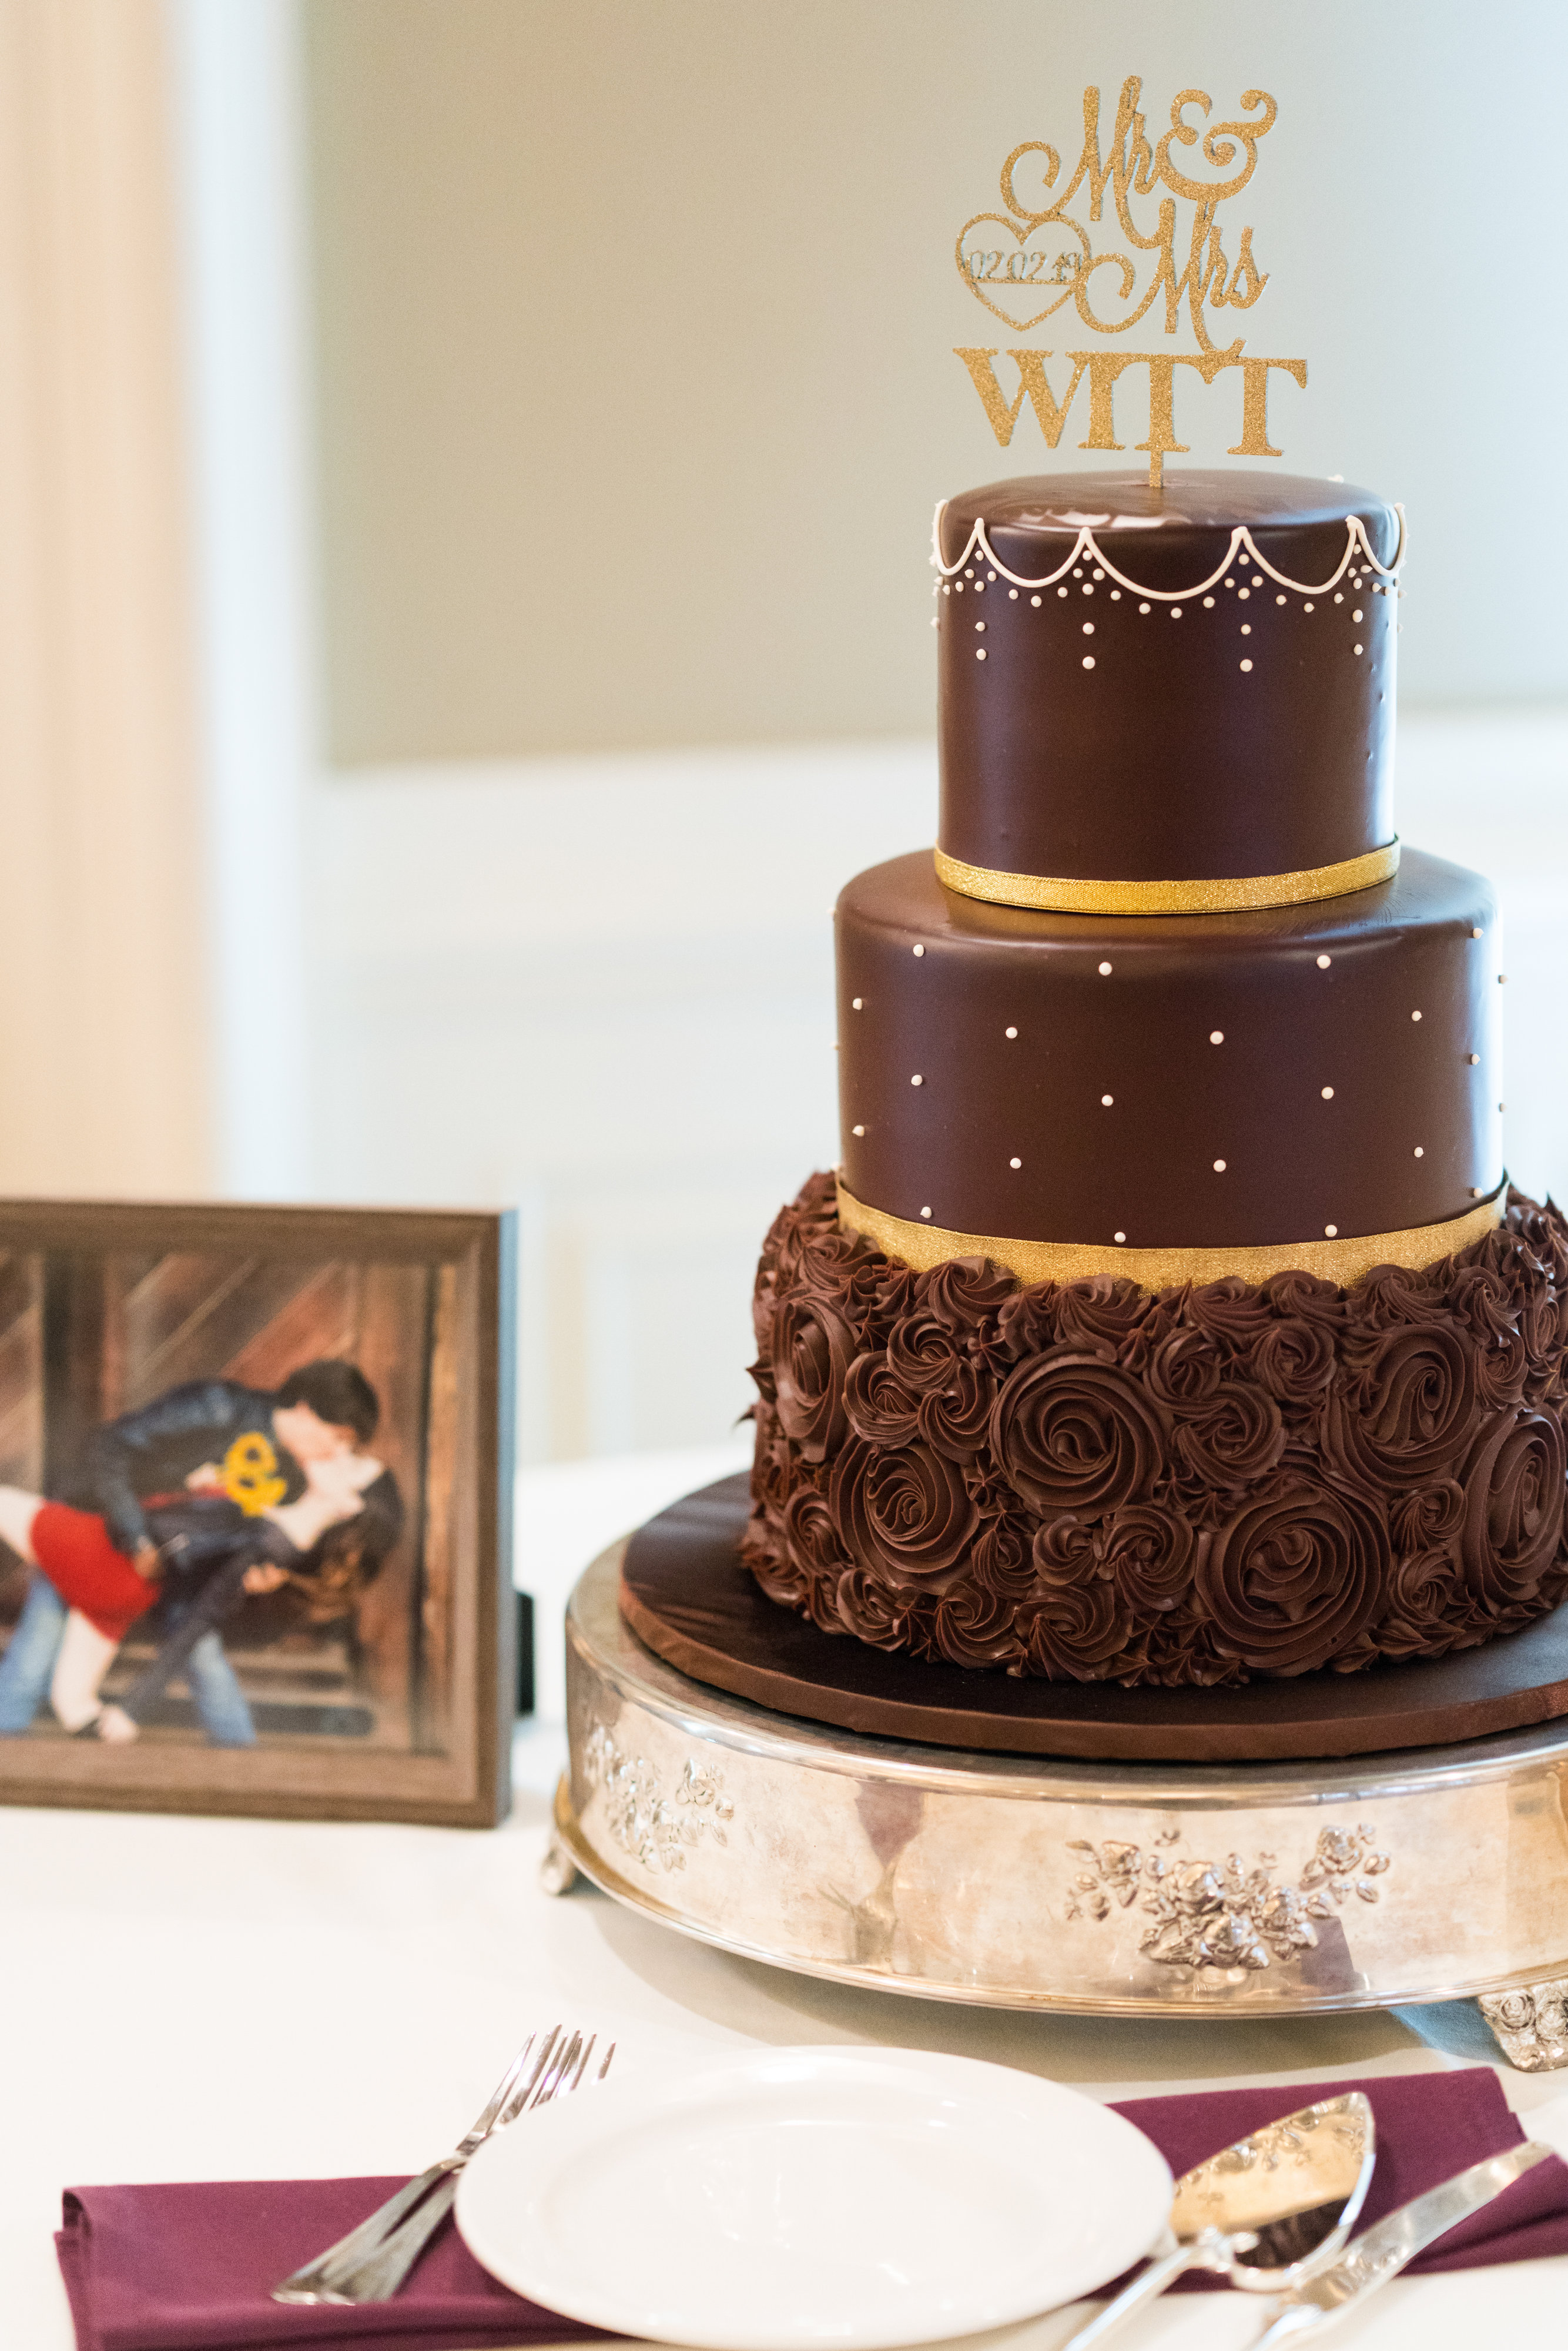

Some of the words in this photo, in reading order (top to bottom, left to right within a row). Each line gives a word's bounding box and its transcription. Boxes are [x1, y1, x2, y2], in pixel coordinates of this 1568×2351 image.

[1000, 75, 1160, 249] Mr
[1155, 89, 1278, 201] &
[1075, 197, 1269, 356] Mrs
[952, 347, 1307, 457] WITT
